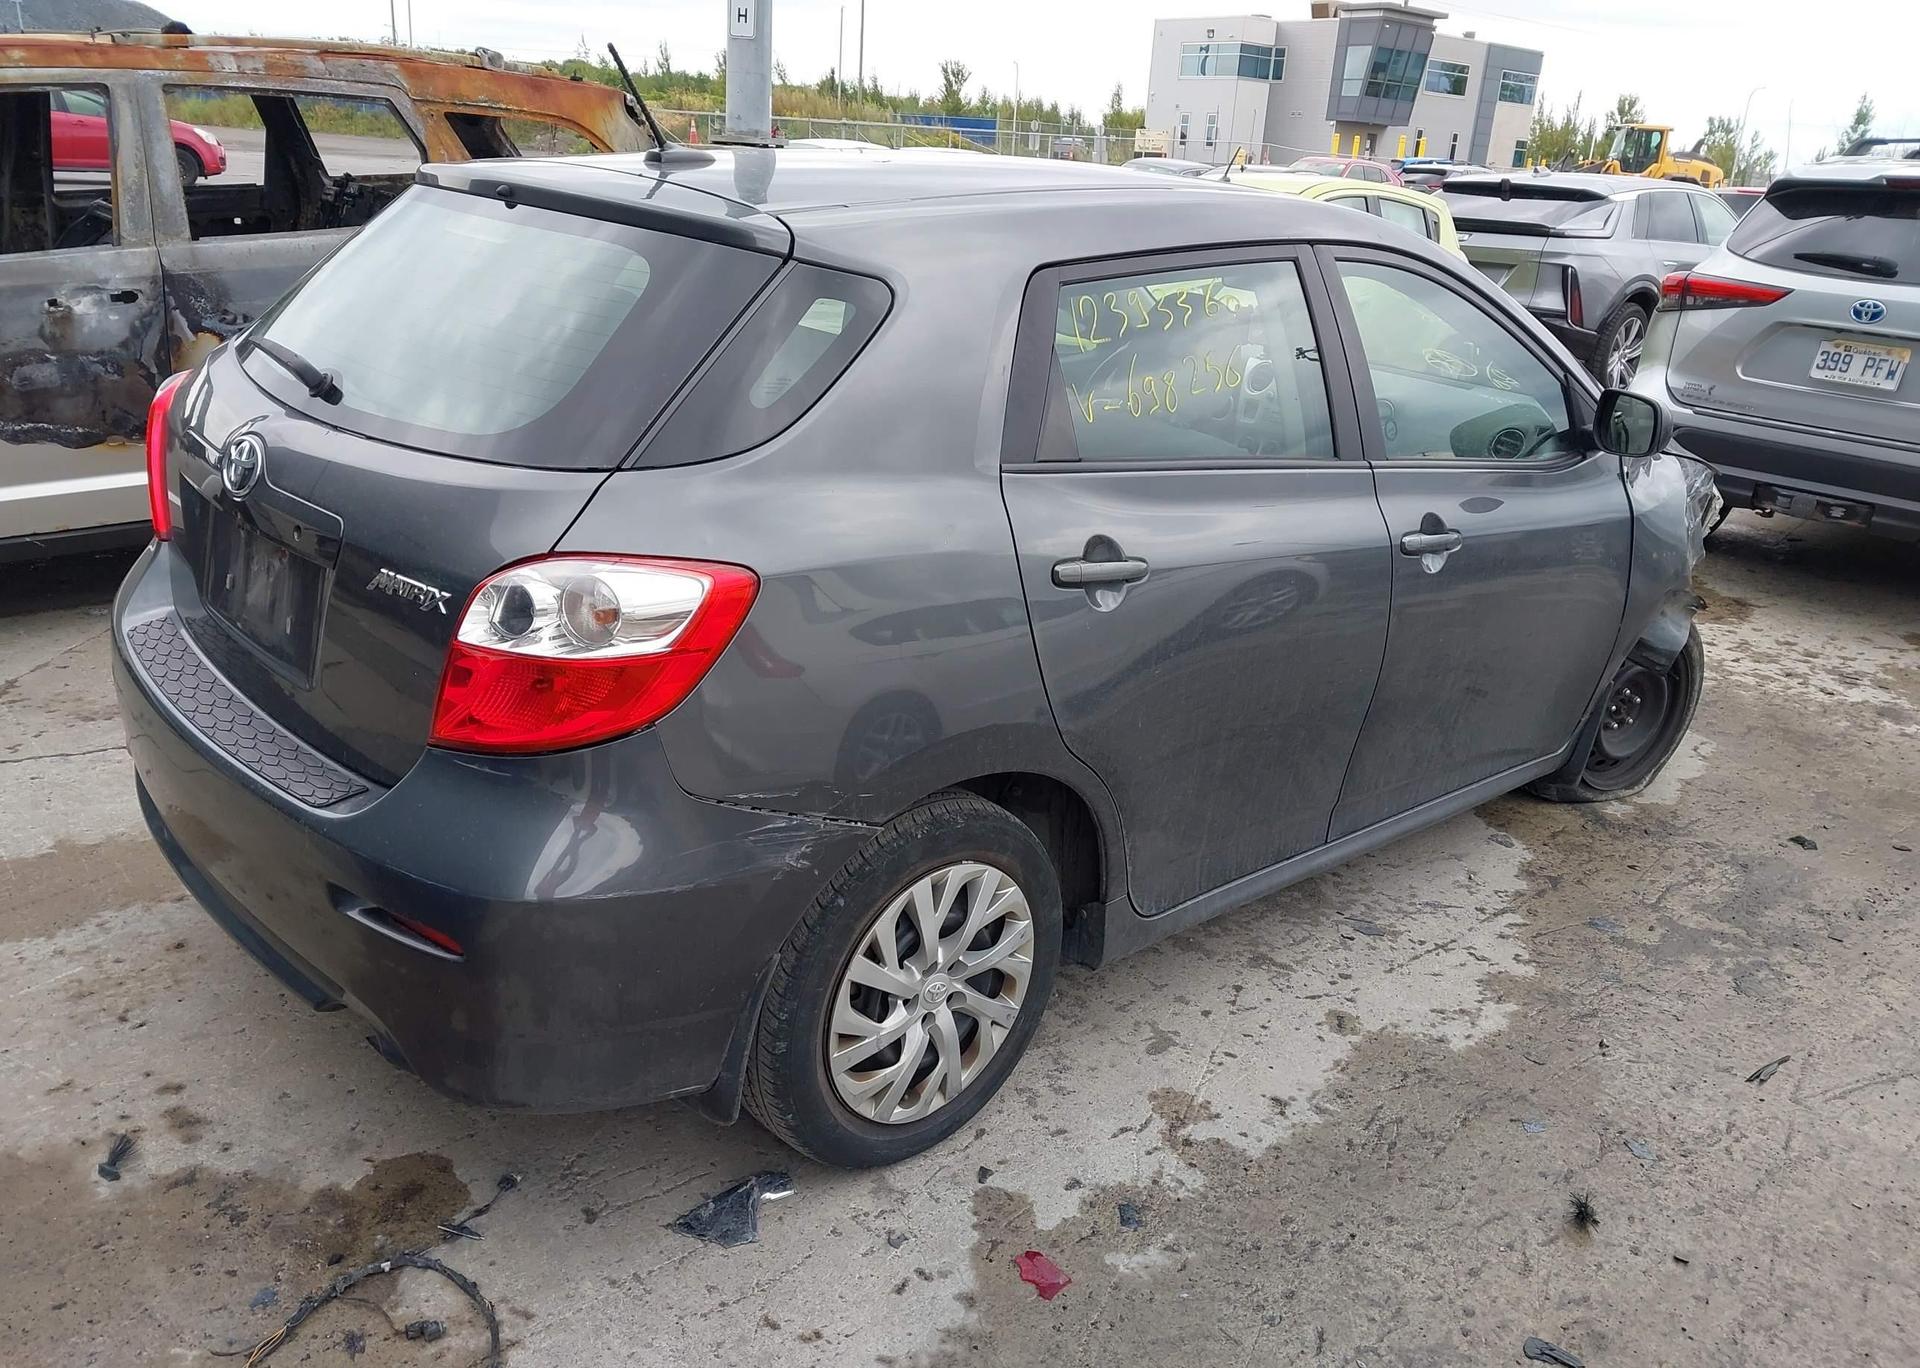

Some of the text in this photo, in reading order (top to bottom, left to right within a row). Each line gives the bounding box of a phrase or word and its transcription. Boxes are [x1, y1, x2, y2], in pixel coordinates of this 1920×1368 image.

[737, 7, 748, 24] H
[1815, 350, 1902, 381] 399 PFW
[366, 568, 452, 614] MATRIX
